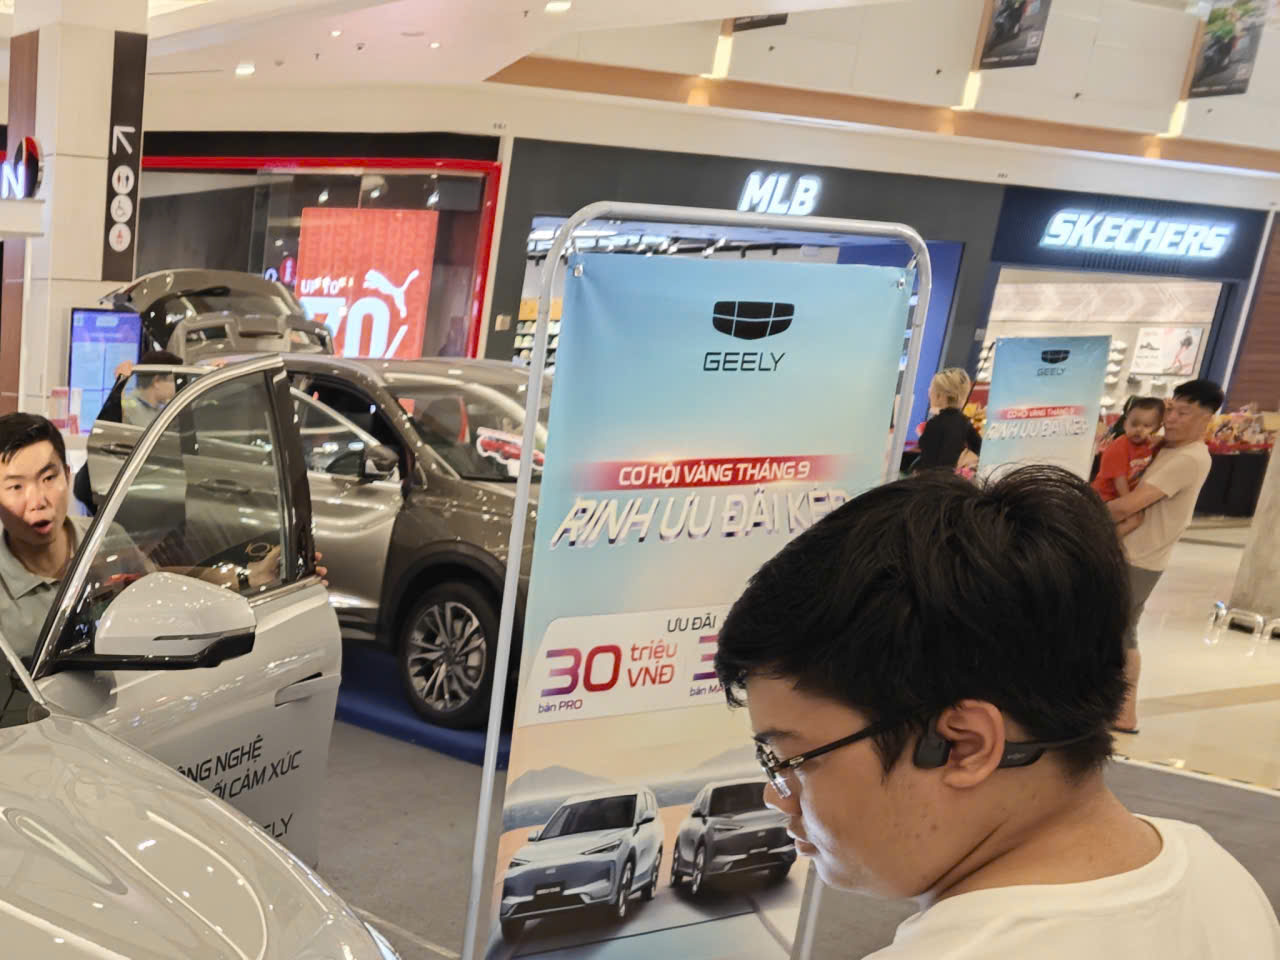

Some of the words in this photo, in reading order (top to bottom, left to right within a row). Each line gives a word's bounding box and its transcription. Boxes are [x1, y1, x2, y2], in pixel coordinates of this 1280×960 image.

[737, 172, 820, 216] MLB
[1039, 208, 1235, 257] SKECHERS
[702, 351, 786, 372] GEELY
[1036, 367, 1066, 377] GEELY
[619, 465, 648, 486] CƠ
[649, 463, 680, 488] HỘI
[684, 459, 733, 483] VÀNG
[735, 457, 796, 481] THÁNG
[797, 460, 812, 479] 9
[549, 495, 660, 549] RINH
[540, 644, 623, 698] 30
[630, 639, 679, 664] triệu
[627, 663, 676, 688] VNĐ
[558, 699, 583, 711] PRO
[708, 683, 725, 694] MA
[214, 734, 264, 776] NGHỆ
[228, 766, 267, 799] CẢM
[267, 750, 303, 781] XÚC
